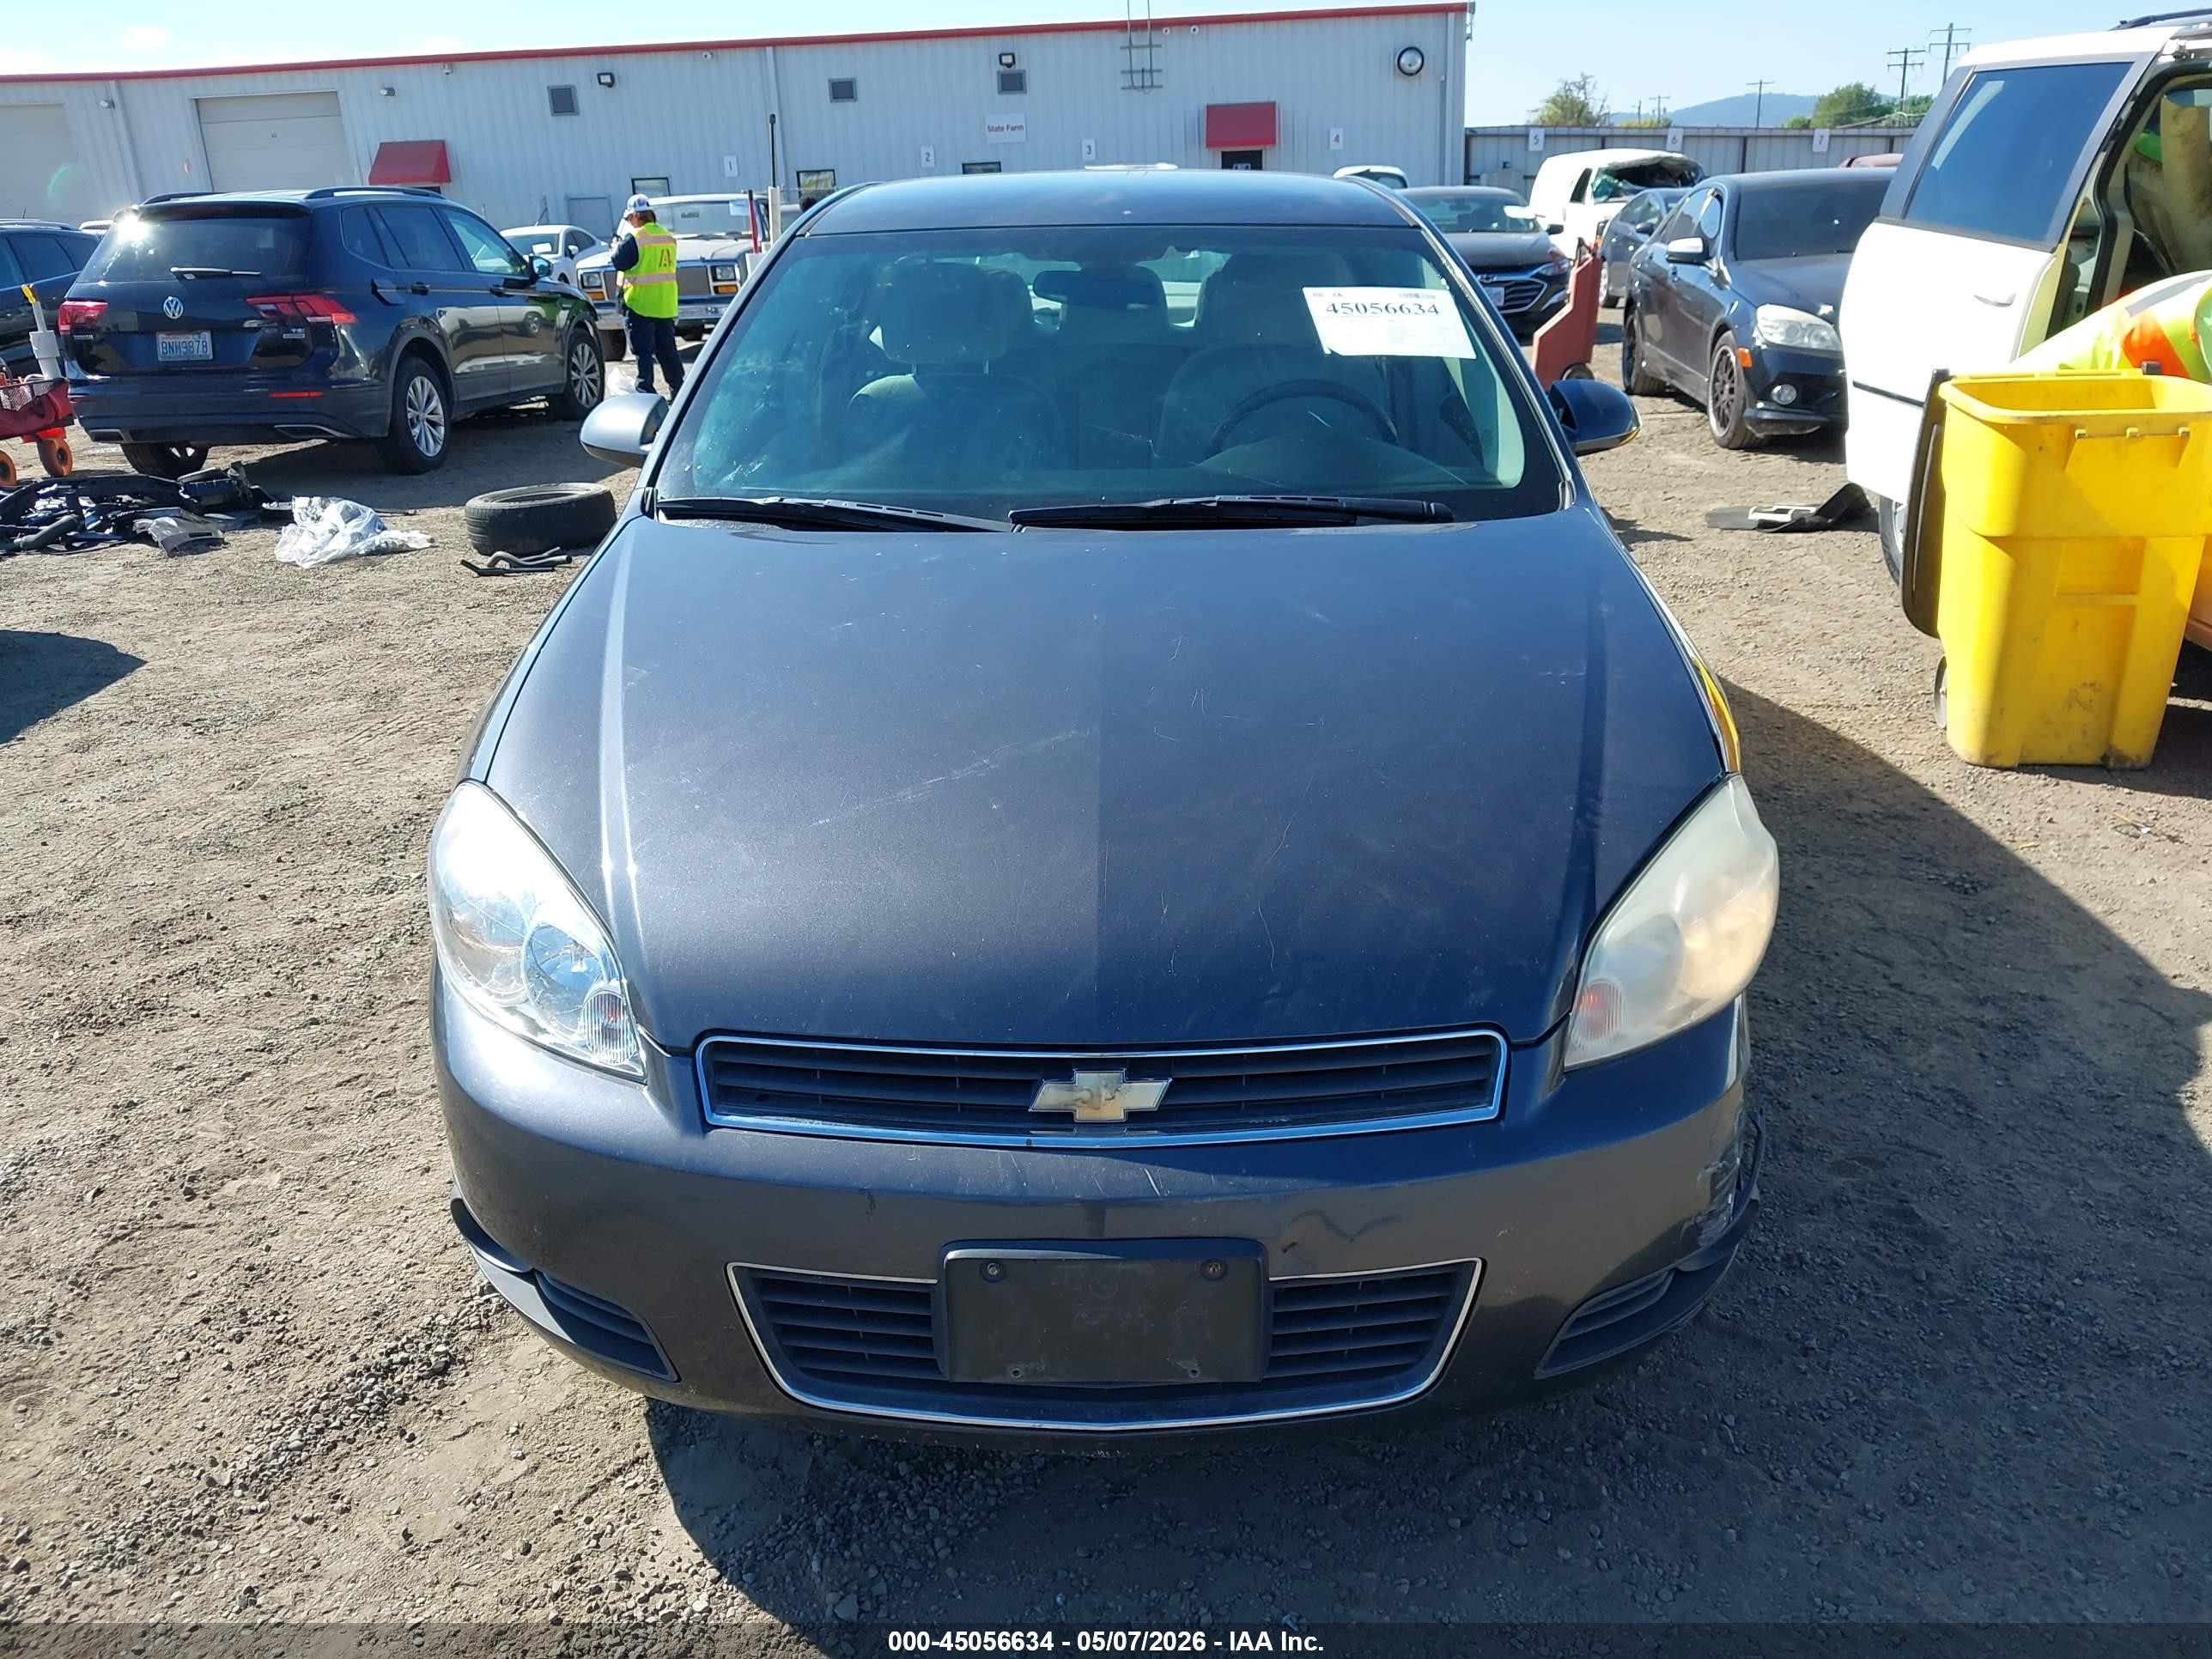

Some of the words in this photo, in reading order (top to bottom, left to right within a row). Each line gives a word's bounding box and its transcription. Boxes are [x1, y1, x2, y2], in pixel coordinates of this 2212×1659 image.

[1333, 134, 1340, 144] 4
[1533, 133, 1540, 145] 5
[1671, 134, 1678, 145] 6
[1819, 134, 1825, 145] 7
[1086, 144, 1092, 155] 3
[924, 151, 931, 162] 2
[1326, 302, 1440, 315] 45056634
